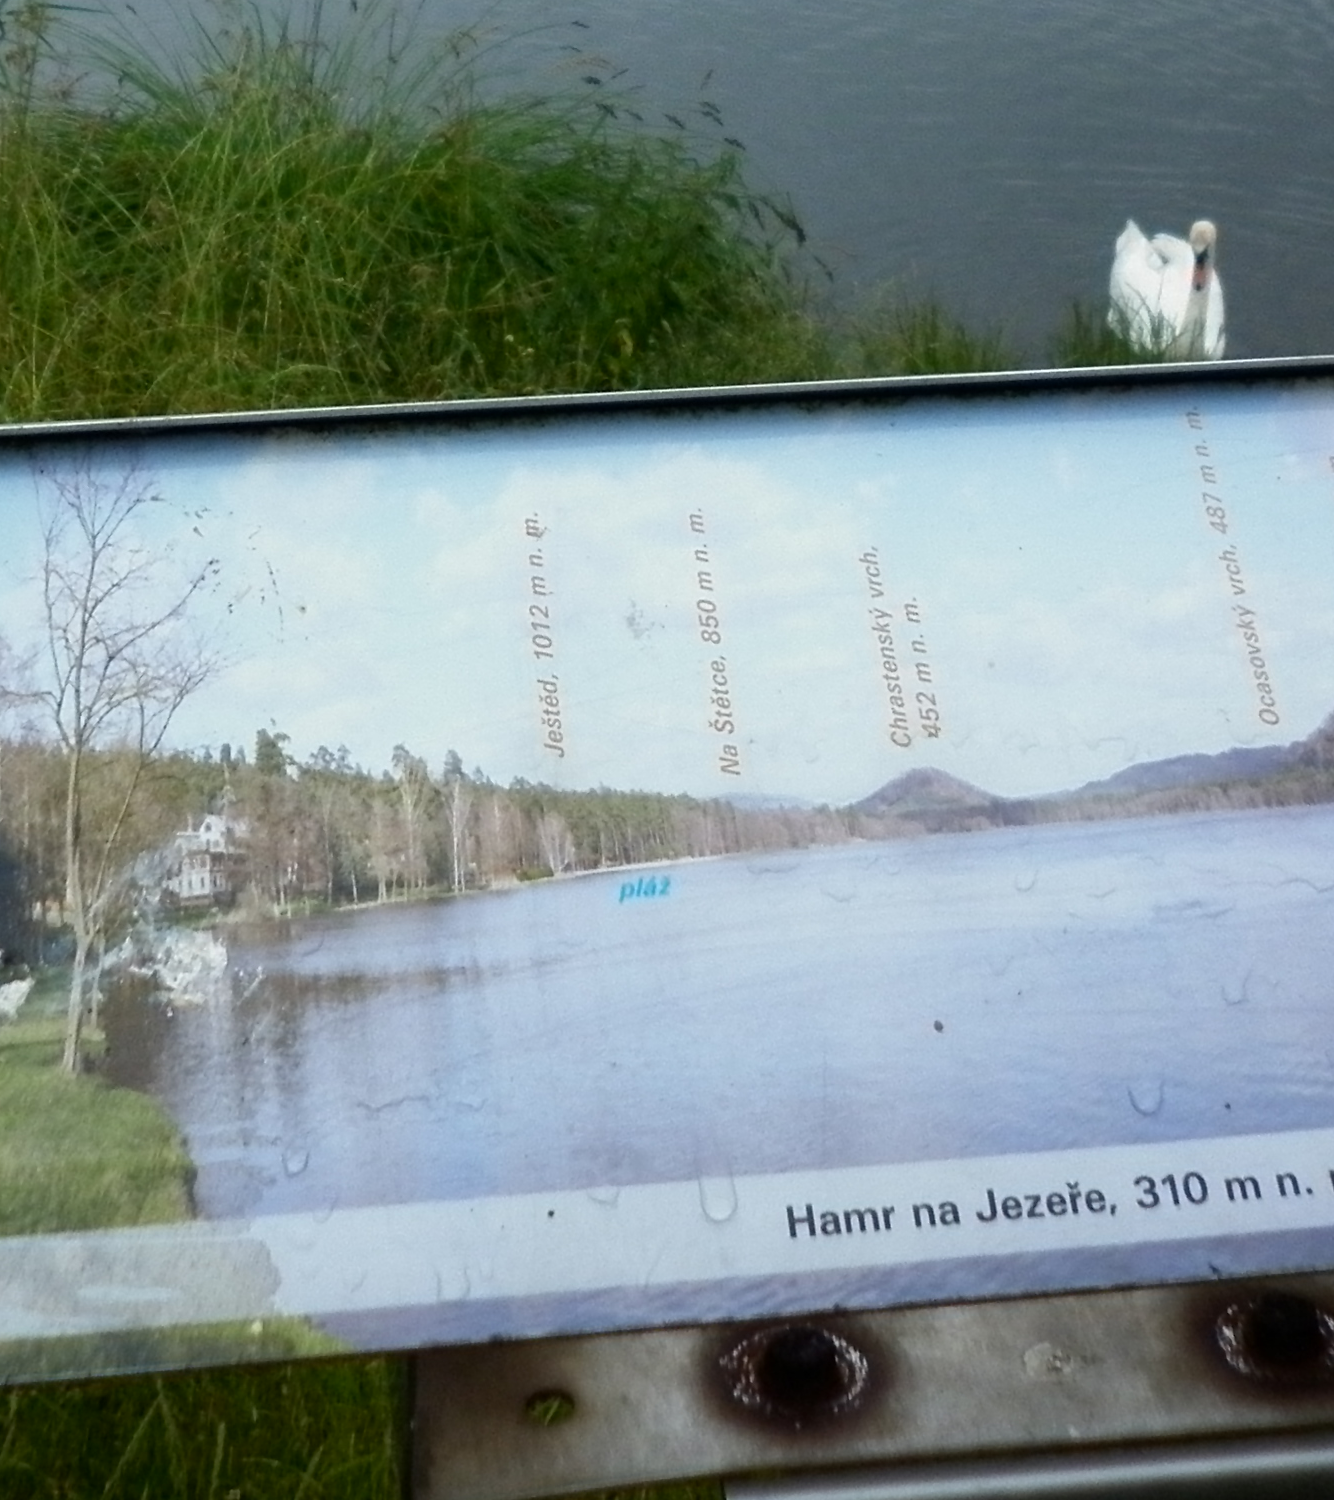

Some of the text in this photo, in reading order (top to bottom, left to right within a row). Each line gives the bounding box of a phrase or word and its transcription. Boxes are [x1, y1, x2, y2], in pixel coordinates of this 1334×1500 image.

[525, 512, 565, 758] Ještěd, 1012 m n. m.
[689, 507, 741, 776] Na Štětce, 850 m n. m.
[858, 546, 912, 749] Chrastenský vrch,
[904, 596, 940, 739] 452 m n. m.
[1187, 406, 1279, 725] Ocasovský vrch, 487 m n. m.
[786, 1203, 894, 1239] Hamr
[912, 1200, 962, 1229] na
[977, 1181, 1118, 1223] Jezeře,
[1136, 1172, 1209, 1210] 310
[1225, 1175, 1262, 1202] m
[1276, 1166, 1313, 1196] n.
